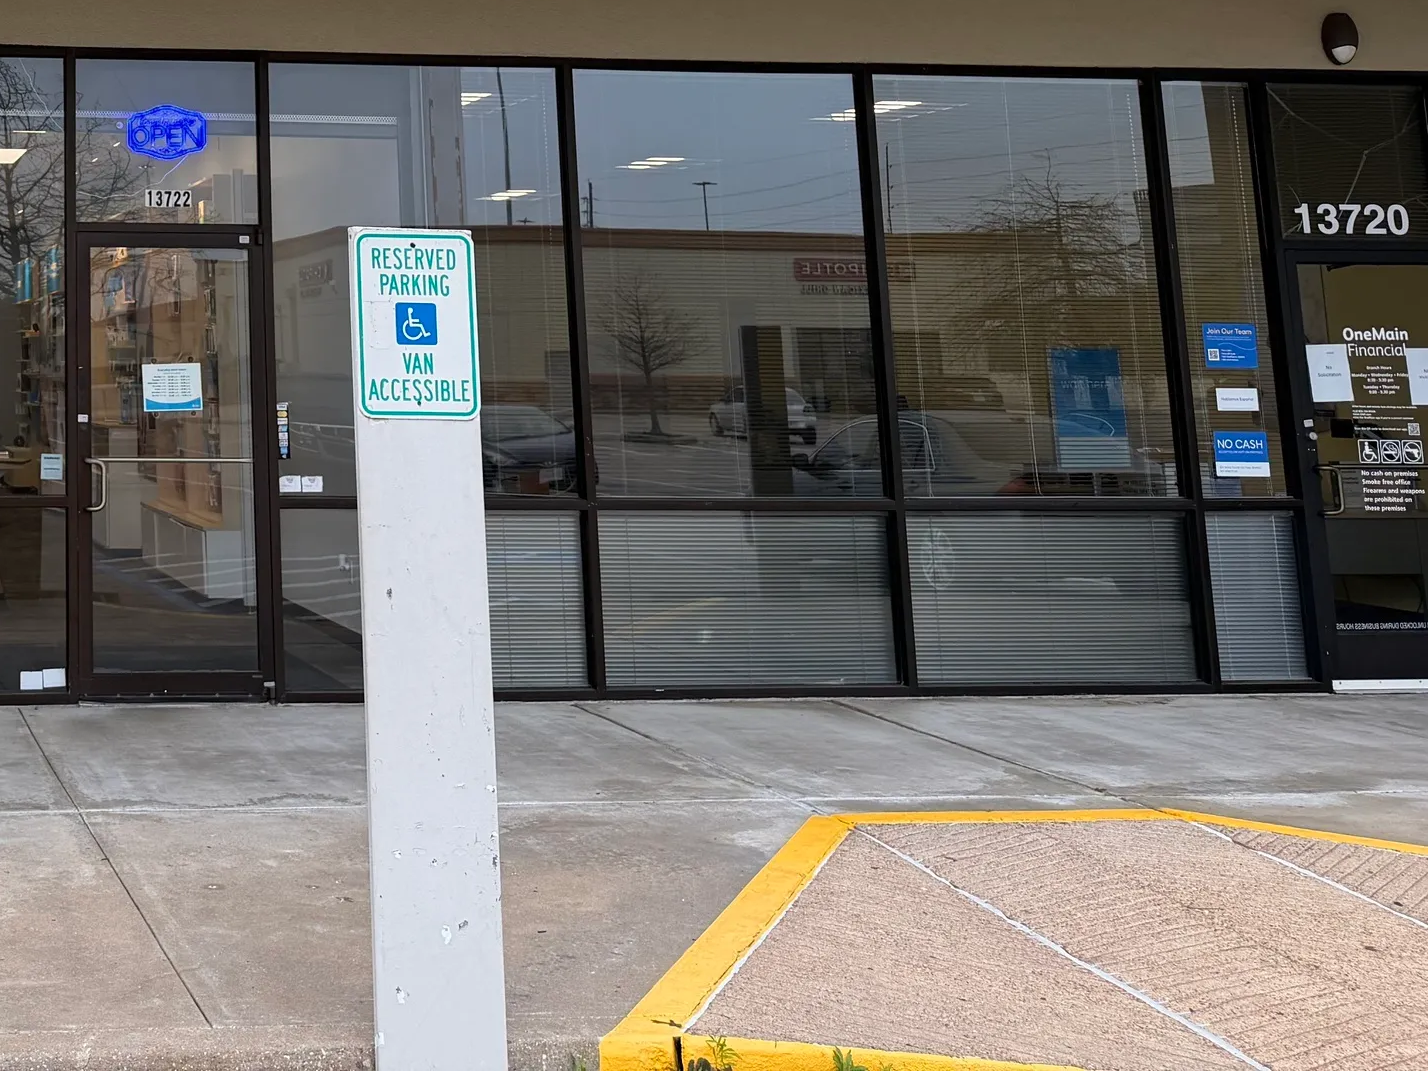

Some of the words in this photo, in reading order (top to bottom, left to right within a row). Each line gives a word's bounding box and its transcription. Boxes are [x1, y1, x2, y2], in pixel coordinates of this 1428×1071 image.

[133, 124, 204, 148] OPEN
[147, 190, 191, 208] 13722
[1294, 203, 1410, 236] 13720
[371, 247, 457, 271] RESERVED
[379, 274, 450, 297] PARKING
[1342, 327, 1409, 341] OneMain
[1347, 342, 1407, 357] Financial
[402, 352, 435, 375] VAN
[368, 379, 471, 403] ACCESSIBLE
[1216, 439, 1233, 449] NO
[1235, 439, 1264, 449] CASH
